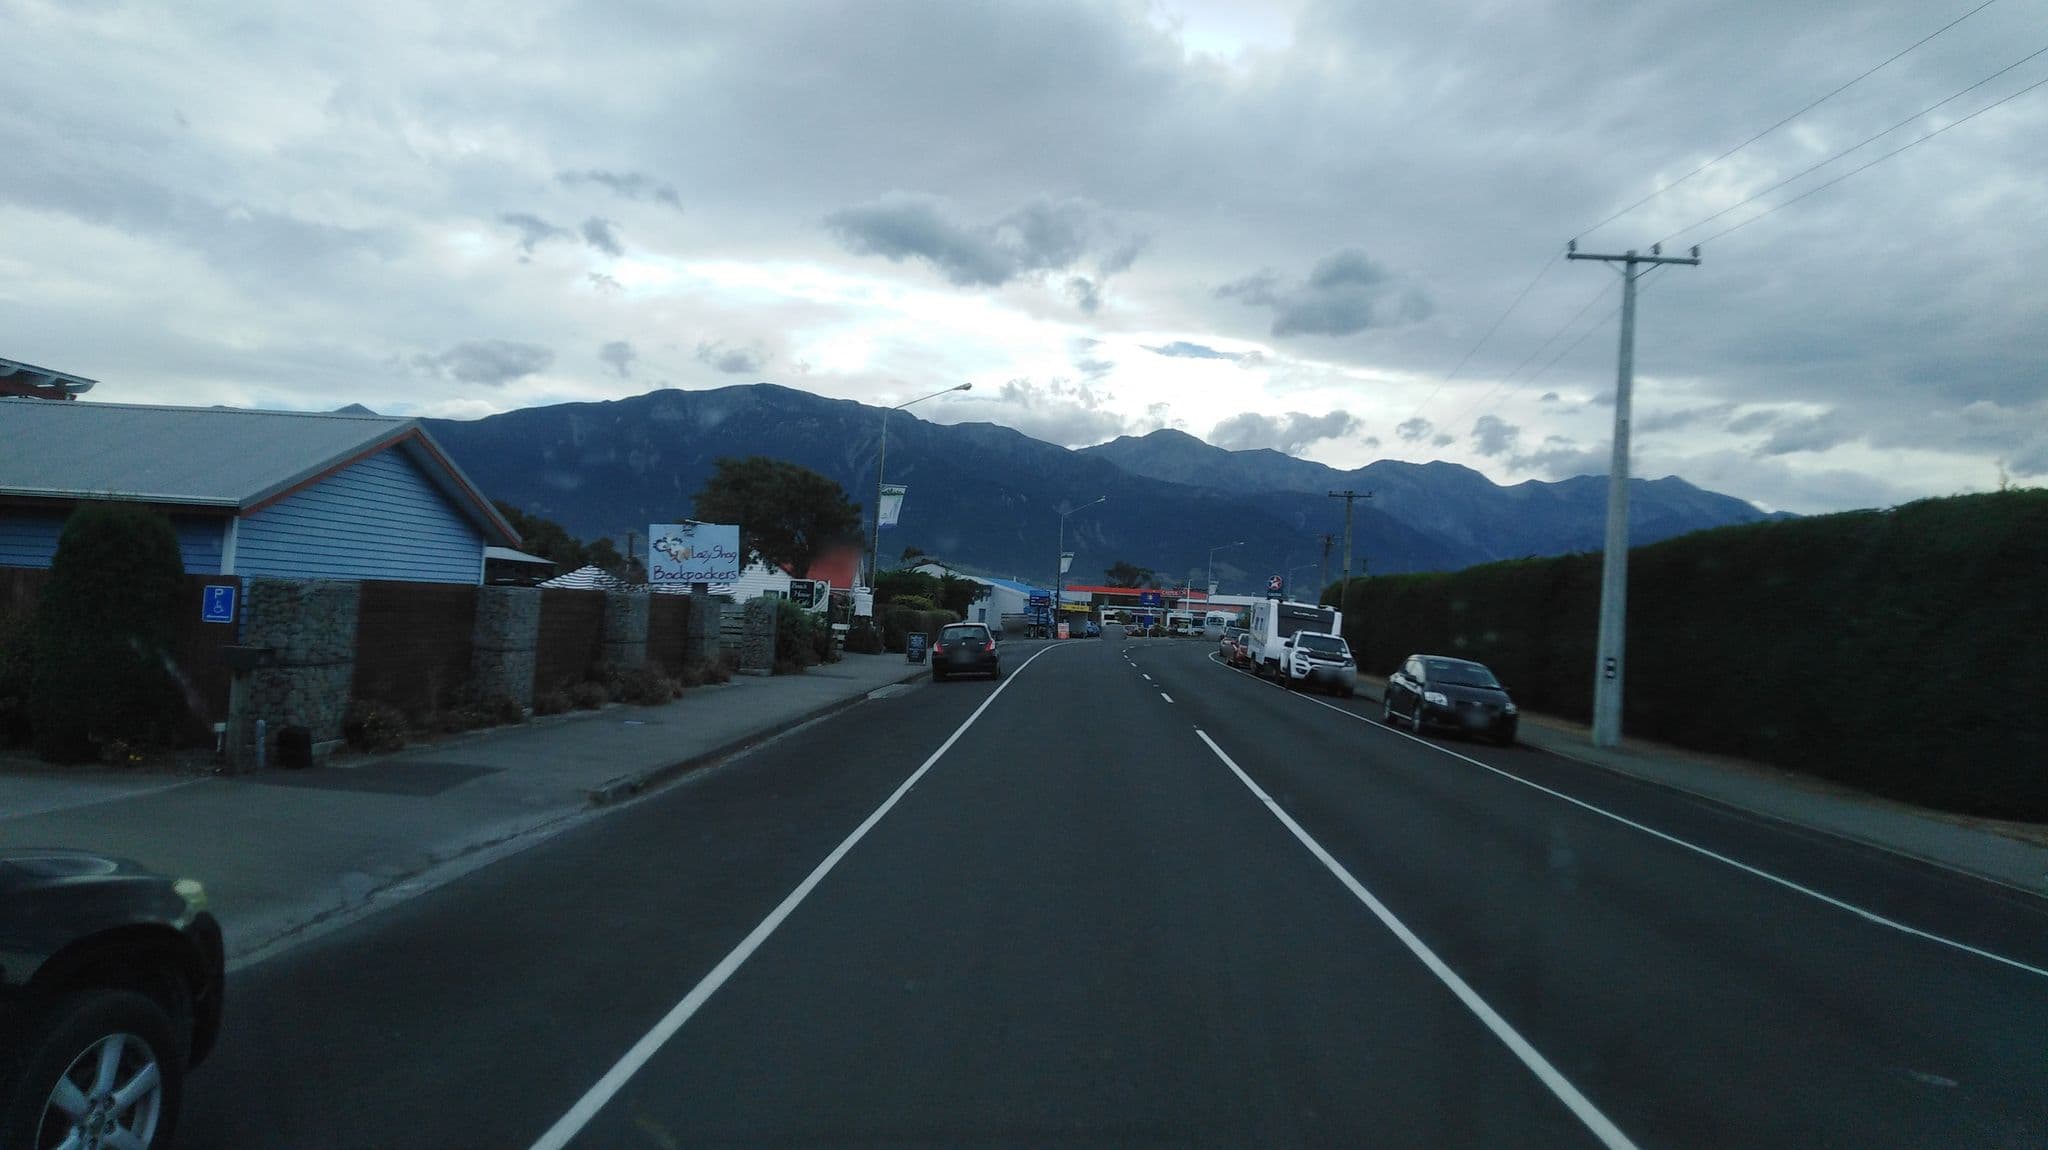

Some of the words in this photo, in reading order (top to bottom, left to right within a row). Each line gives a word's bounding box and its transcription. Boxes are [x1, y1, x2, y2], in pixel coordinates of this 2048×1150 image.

[691, 545, 712, 564] Lazy
[711, 545, 737, 564] Shag
[653, 565, 737, 581] Backpackers
[215, 588, 224, 599] P
